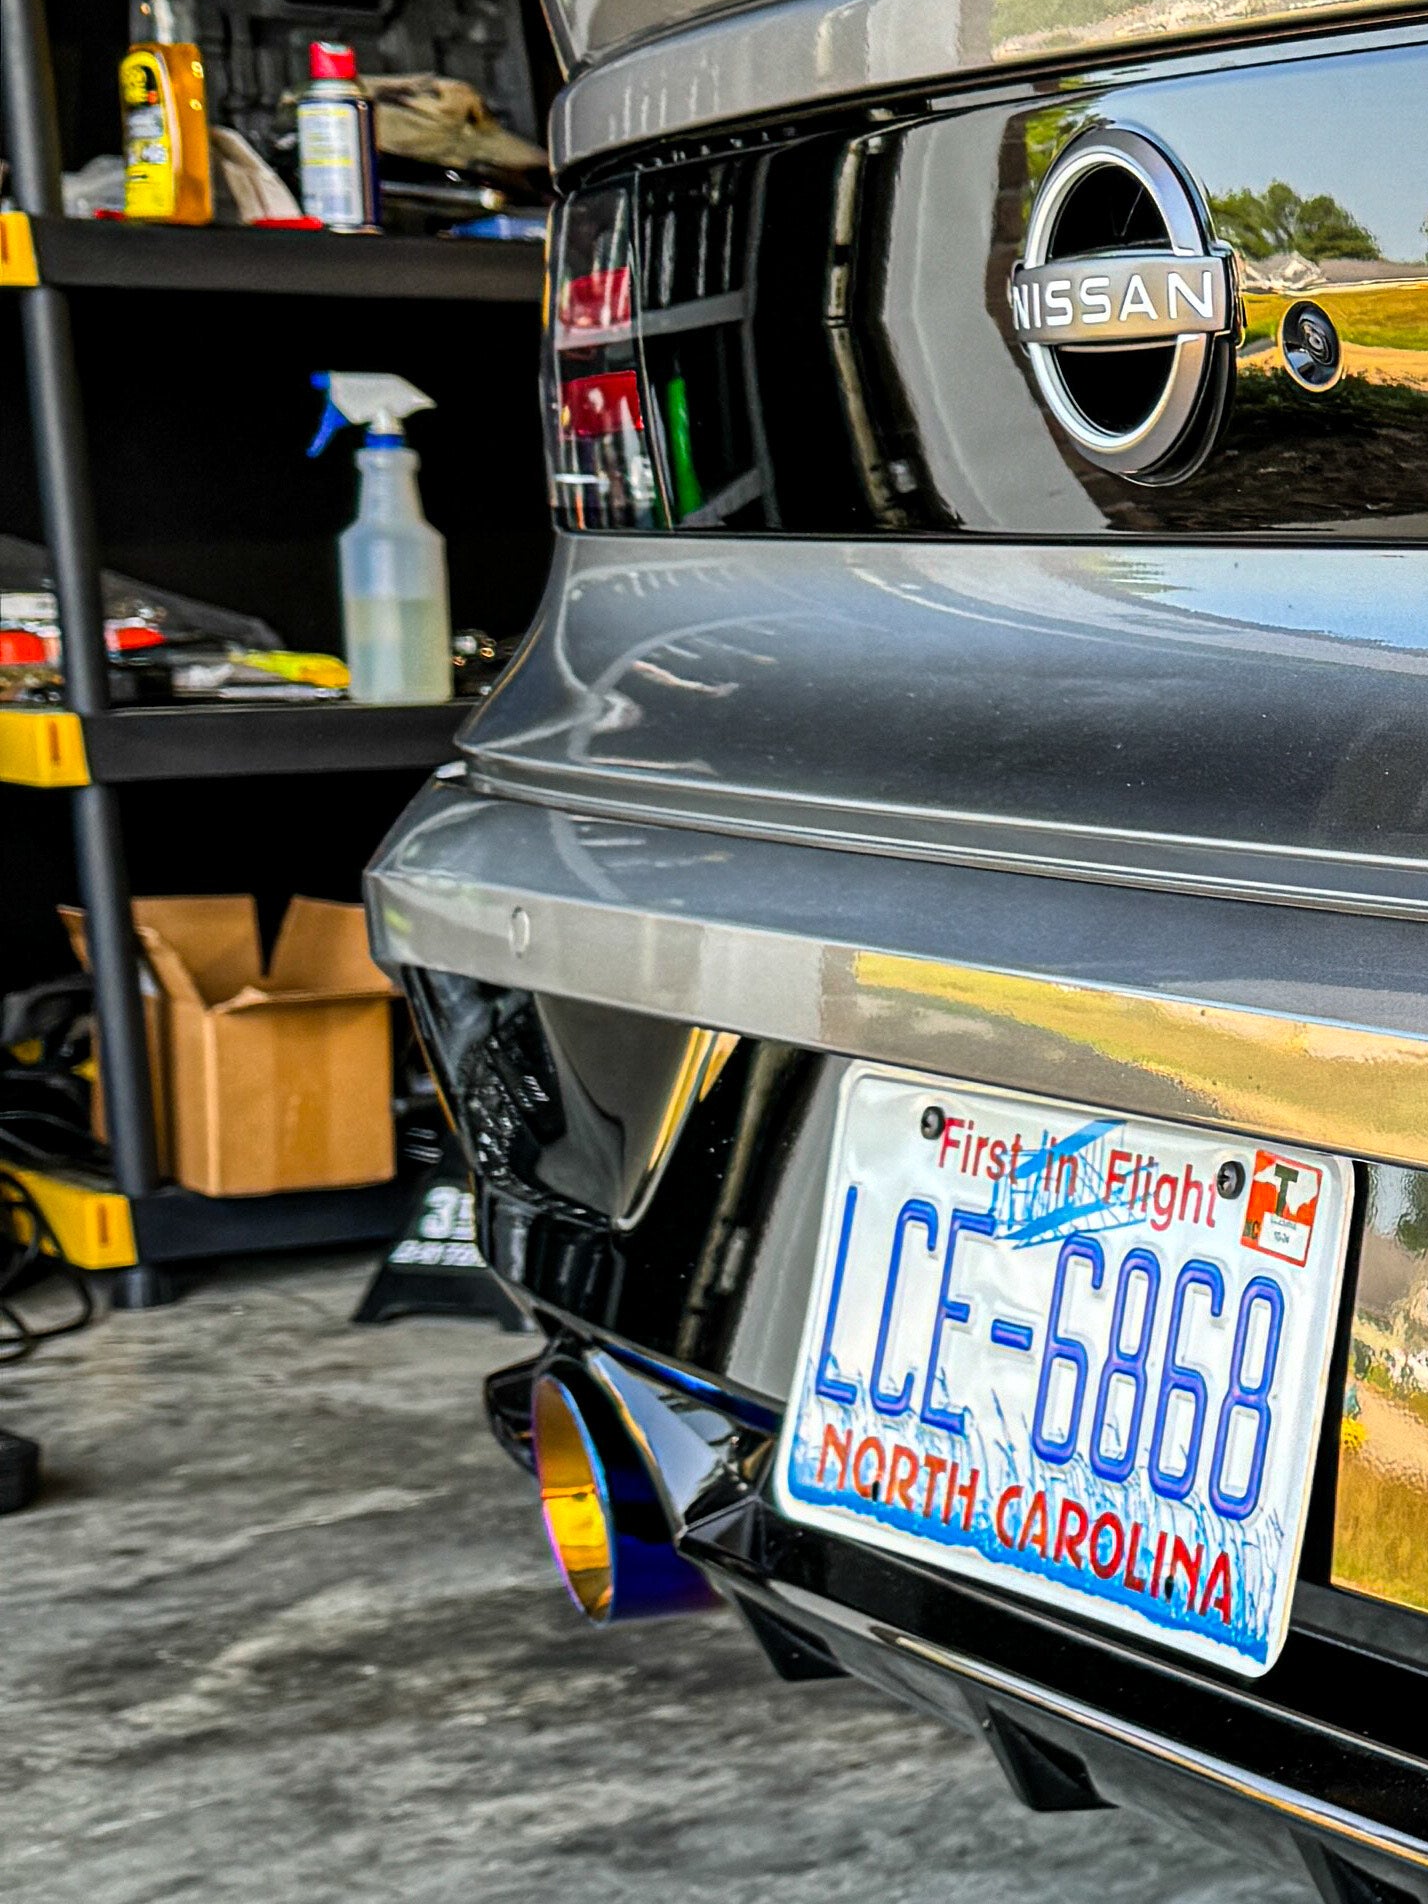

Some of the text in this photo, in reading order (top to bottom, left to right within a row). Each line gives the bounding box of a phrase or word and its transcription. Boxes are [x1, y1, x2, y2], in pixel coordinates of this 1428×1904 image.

[1012, 270, 1214, 331] NISSAN
[937, 1116, 1024, 1186] First
[1102, 1148, 1218, 1232] Flight
[816, 1184, 1285, 1521] LCE-6868
[816, 1423, 1233, 1626] NORTH CAROLINA
